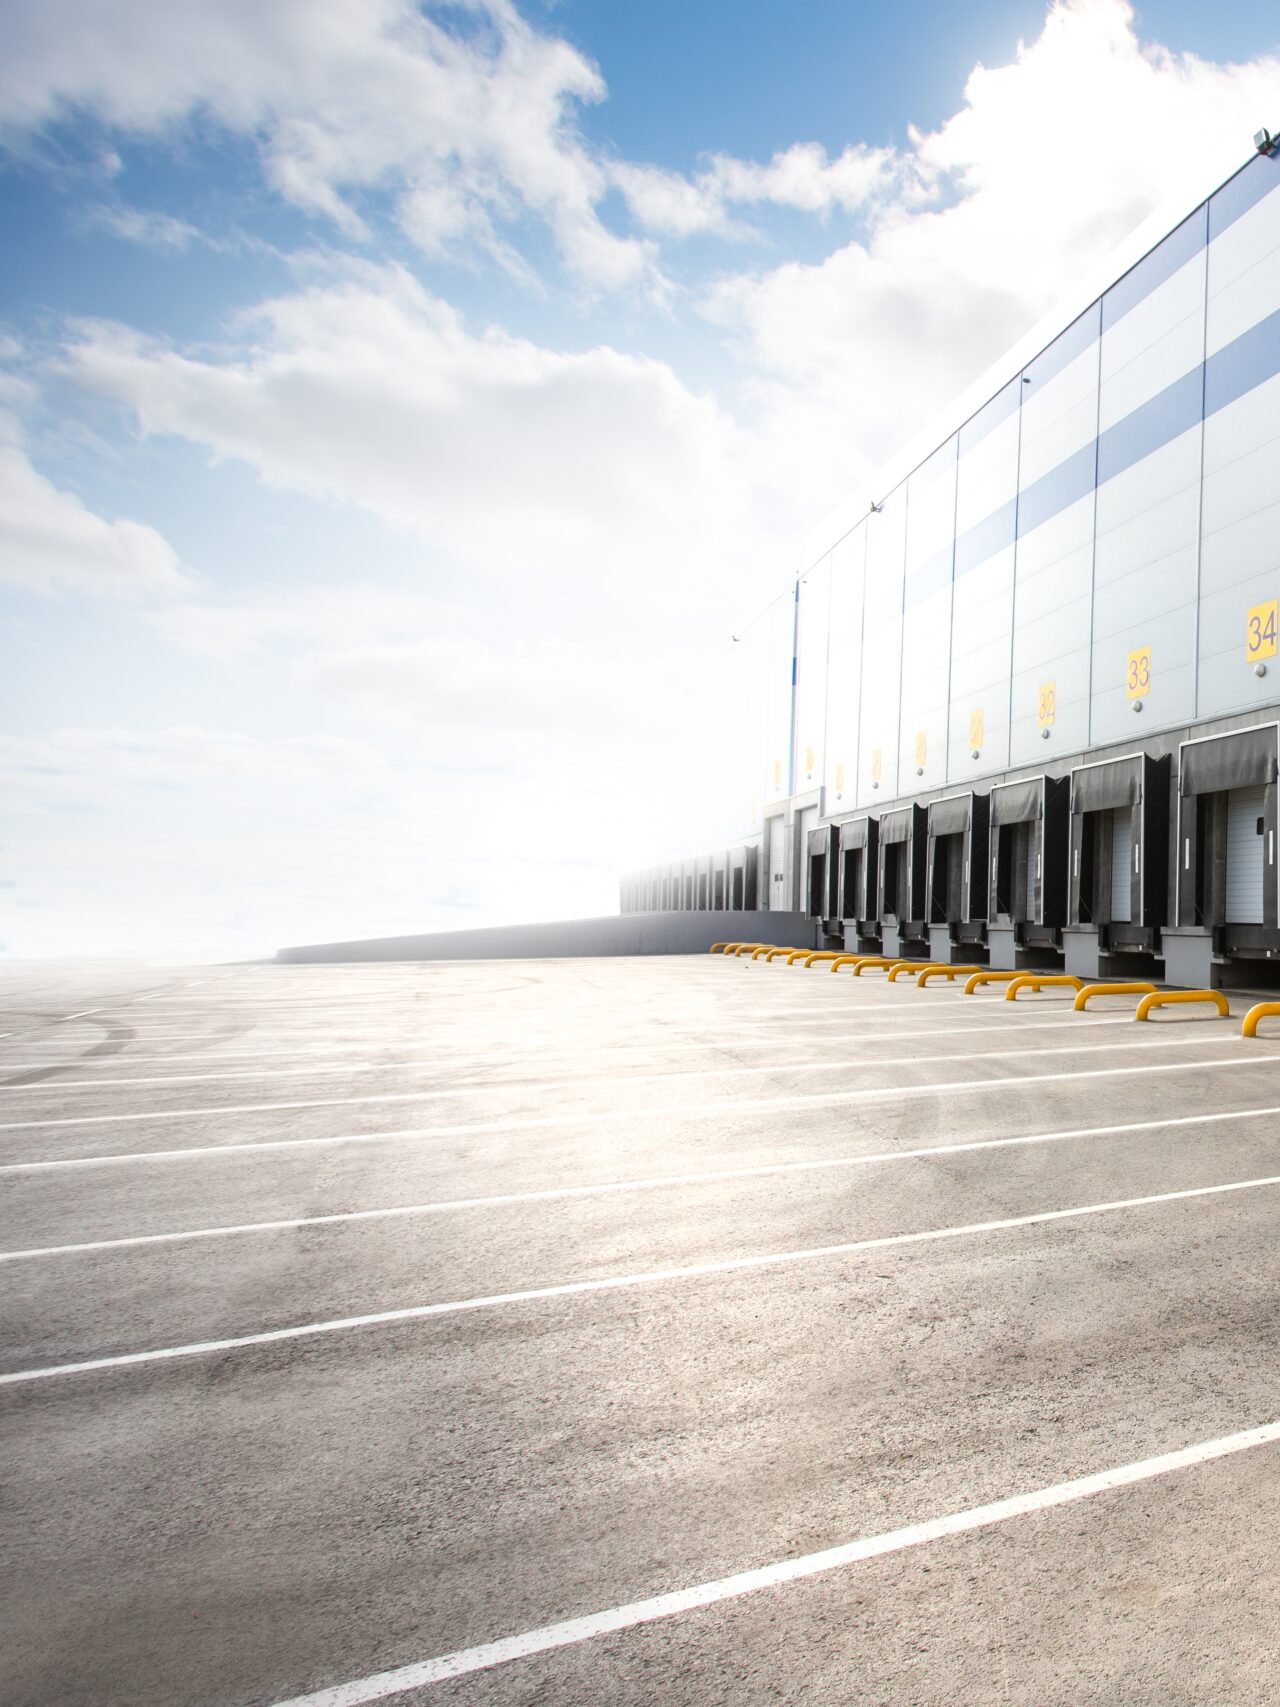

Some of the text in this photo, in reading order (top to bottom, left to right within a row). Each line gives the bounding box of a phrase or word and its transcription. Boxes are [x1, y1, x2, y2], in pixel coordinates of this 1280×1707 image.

[1248, 609, 1277, 652] 34
[1128, 655, 1149, 690] 33
[1038, 690, 1055, 720] 32
